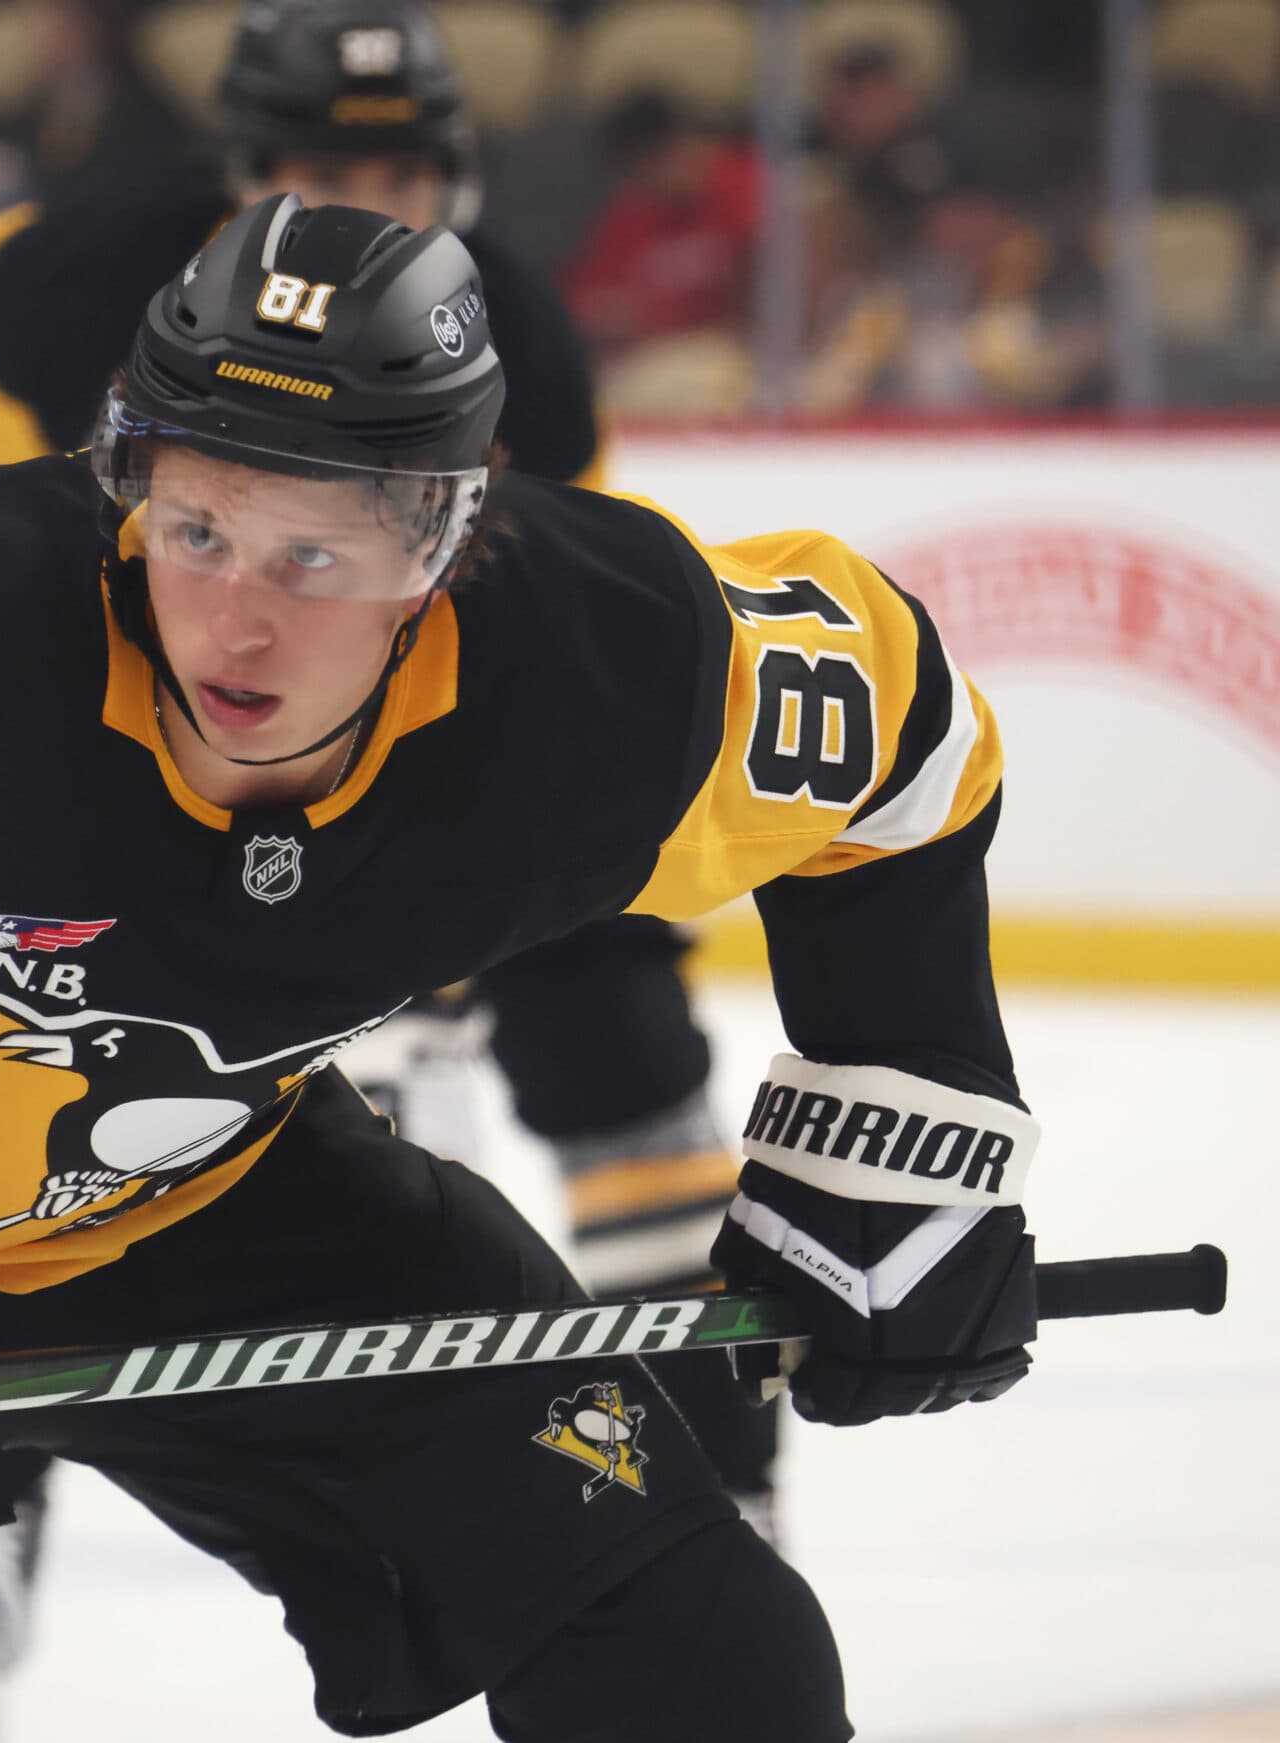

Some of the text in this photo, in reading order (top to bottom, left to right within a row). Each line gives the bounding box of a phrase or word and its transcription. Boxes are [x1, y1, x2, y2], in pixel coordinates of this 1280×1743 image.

[256, 272, 336, 333] 81
[216, 360, 334, 401] WARRIOR
[719, 576, 880, 812] 81
[255, 853, 291, 889] NHL
[791, 1248, 852, 1293] ALPHA
[108, 1299, 707, 1399] WARRIOR
